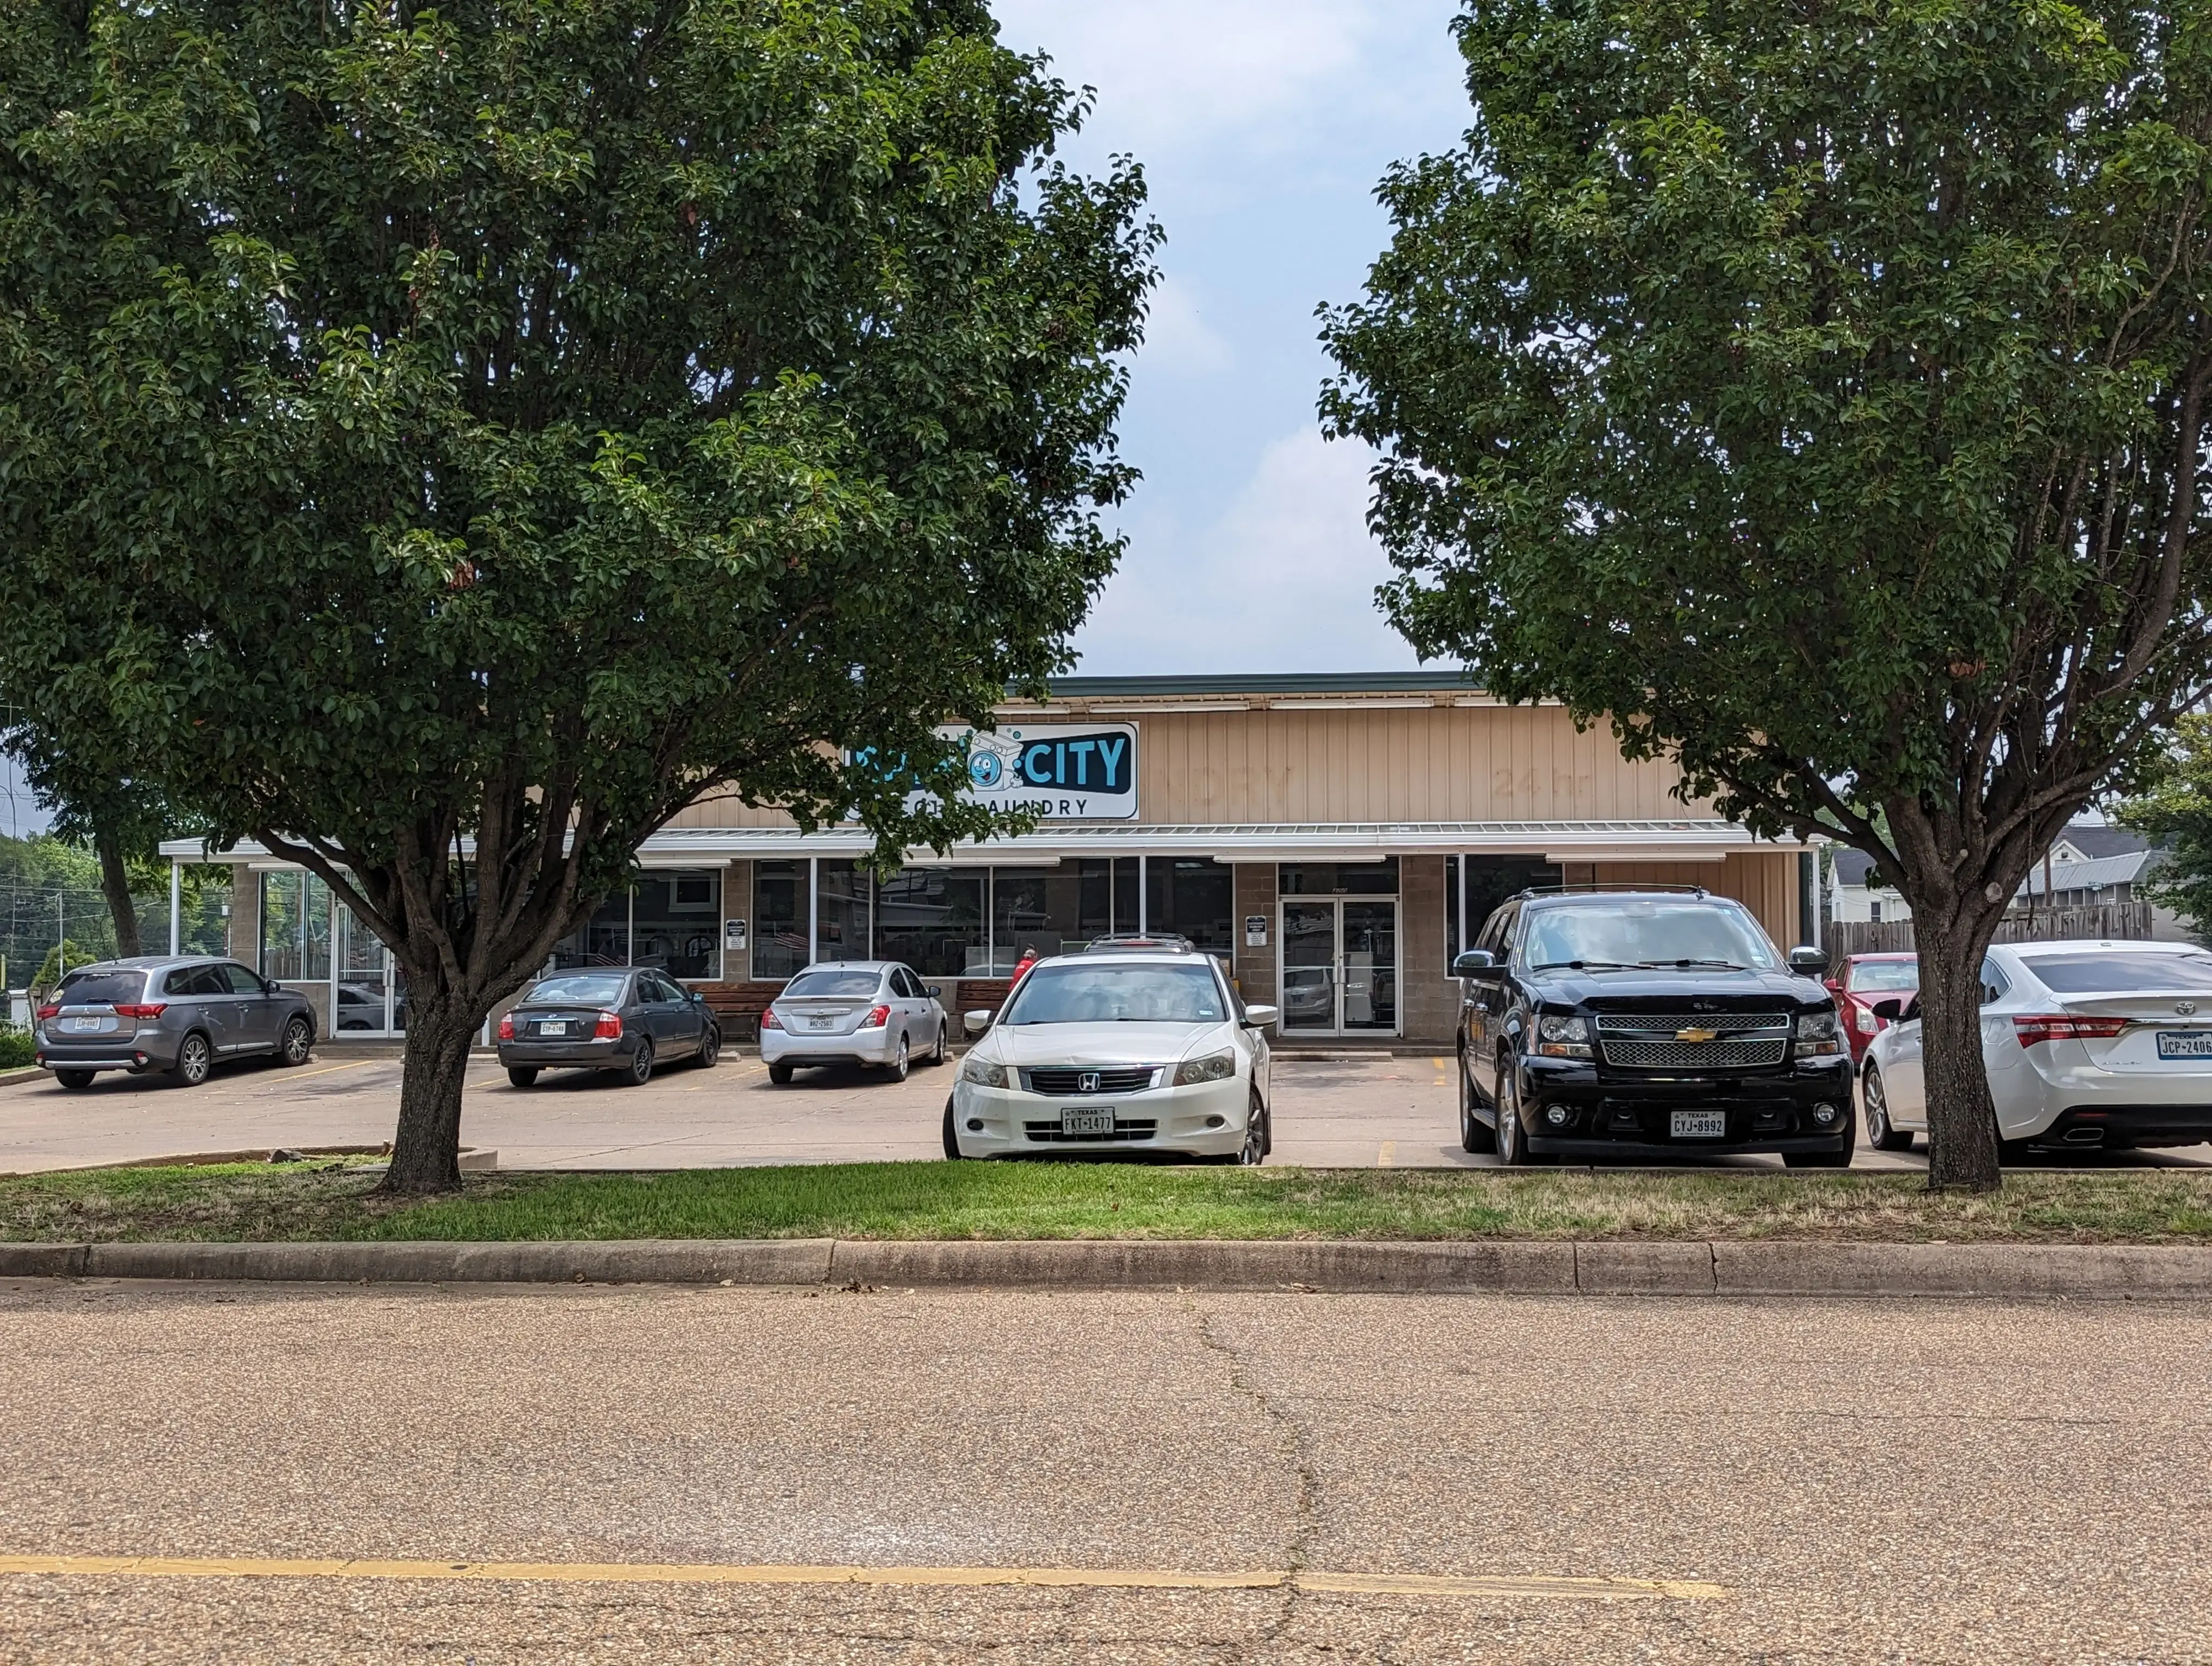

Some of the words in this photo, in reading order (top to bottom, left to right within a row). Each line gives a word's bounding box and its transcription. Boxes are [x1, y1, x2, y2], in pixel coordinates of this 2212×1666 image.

[1025, 738, 1126, 786] CITY
[2163, 1041, 2212, 1054] JCP-2406
[1065, 1117, 1110, 1130] FKT-1477
[1675, 1120, 1722, 1132] CYJ-8992
